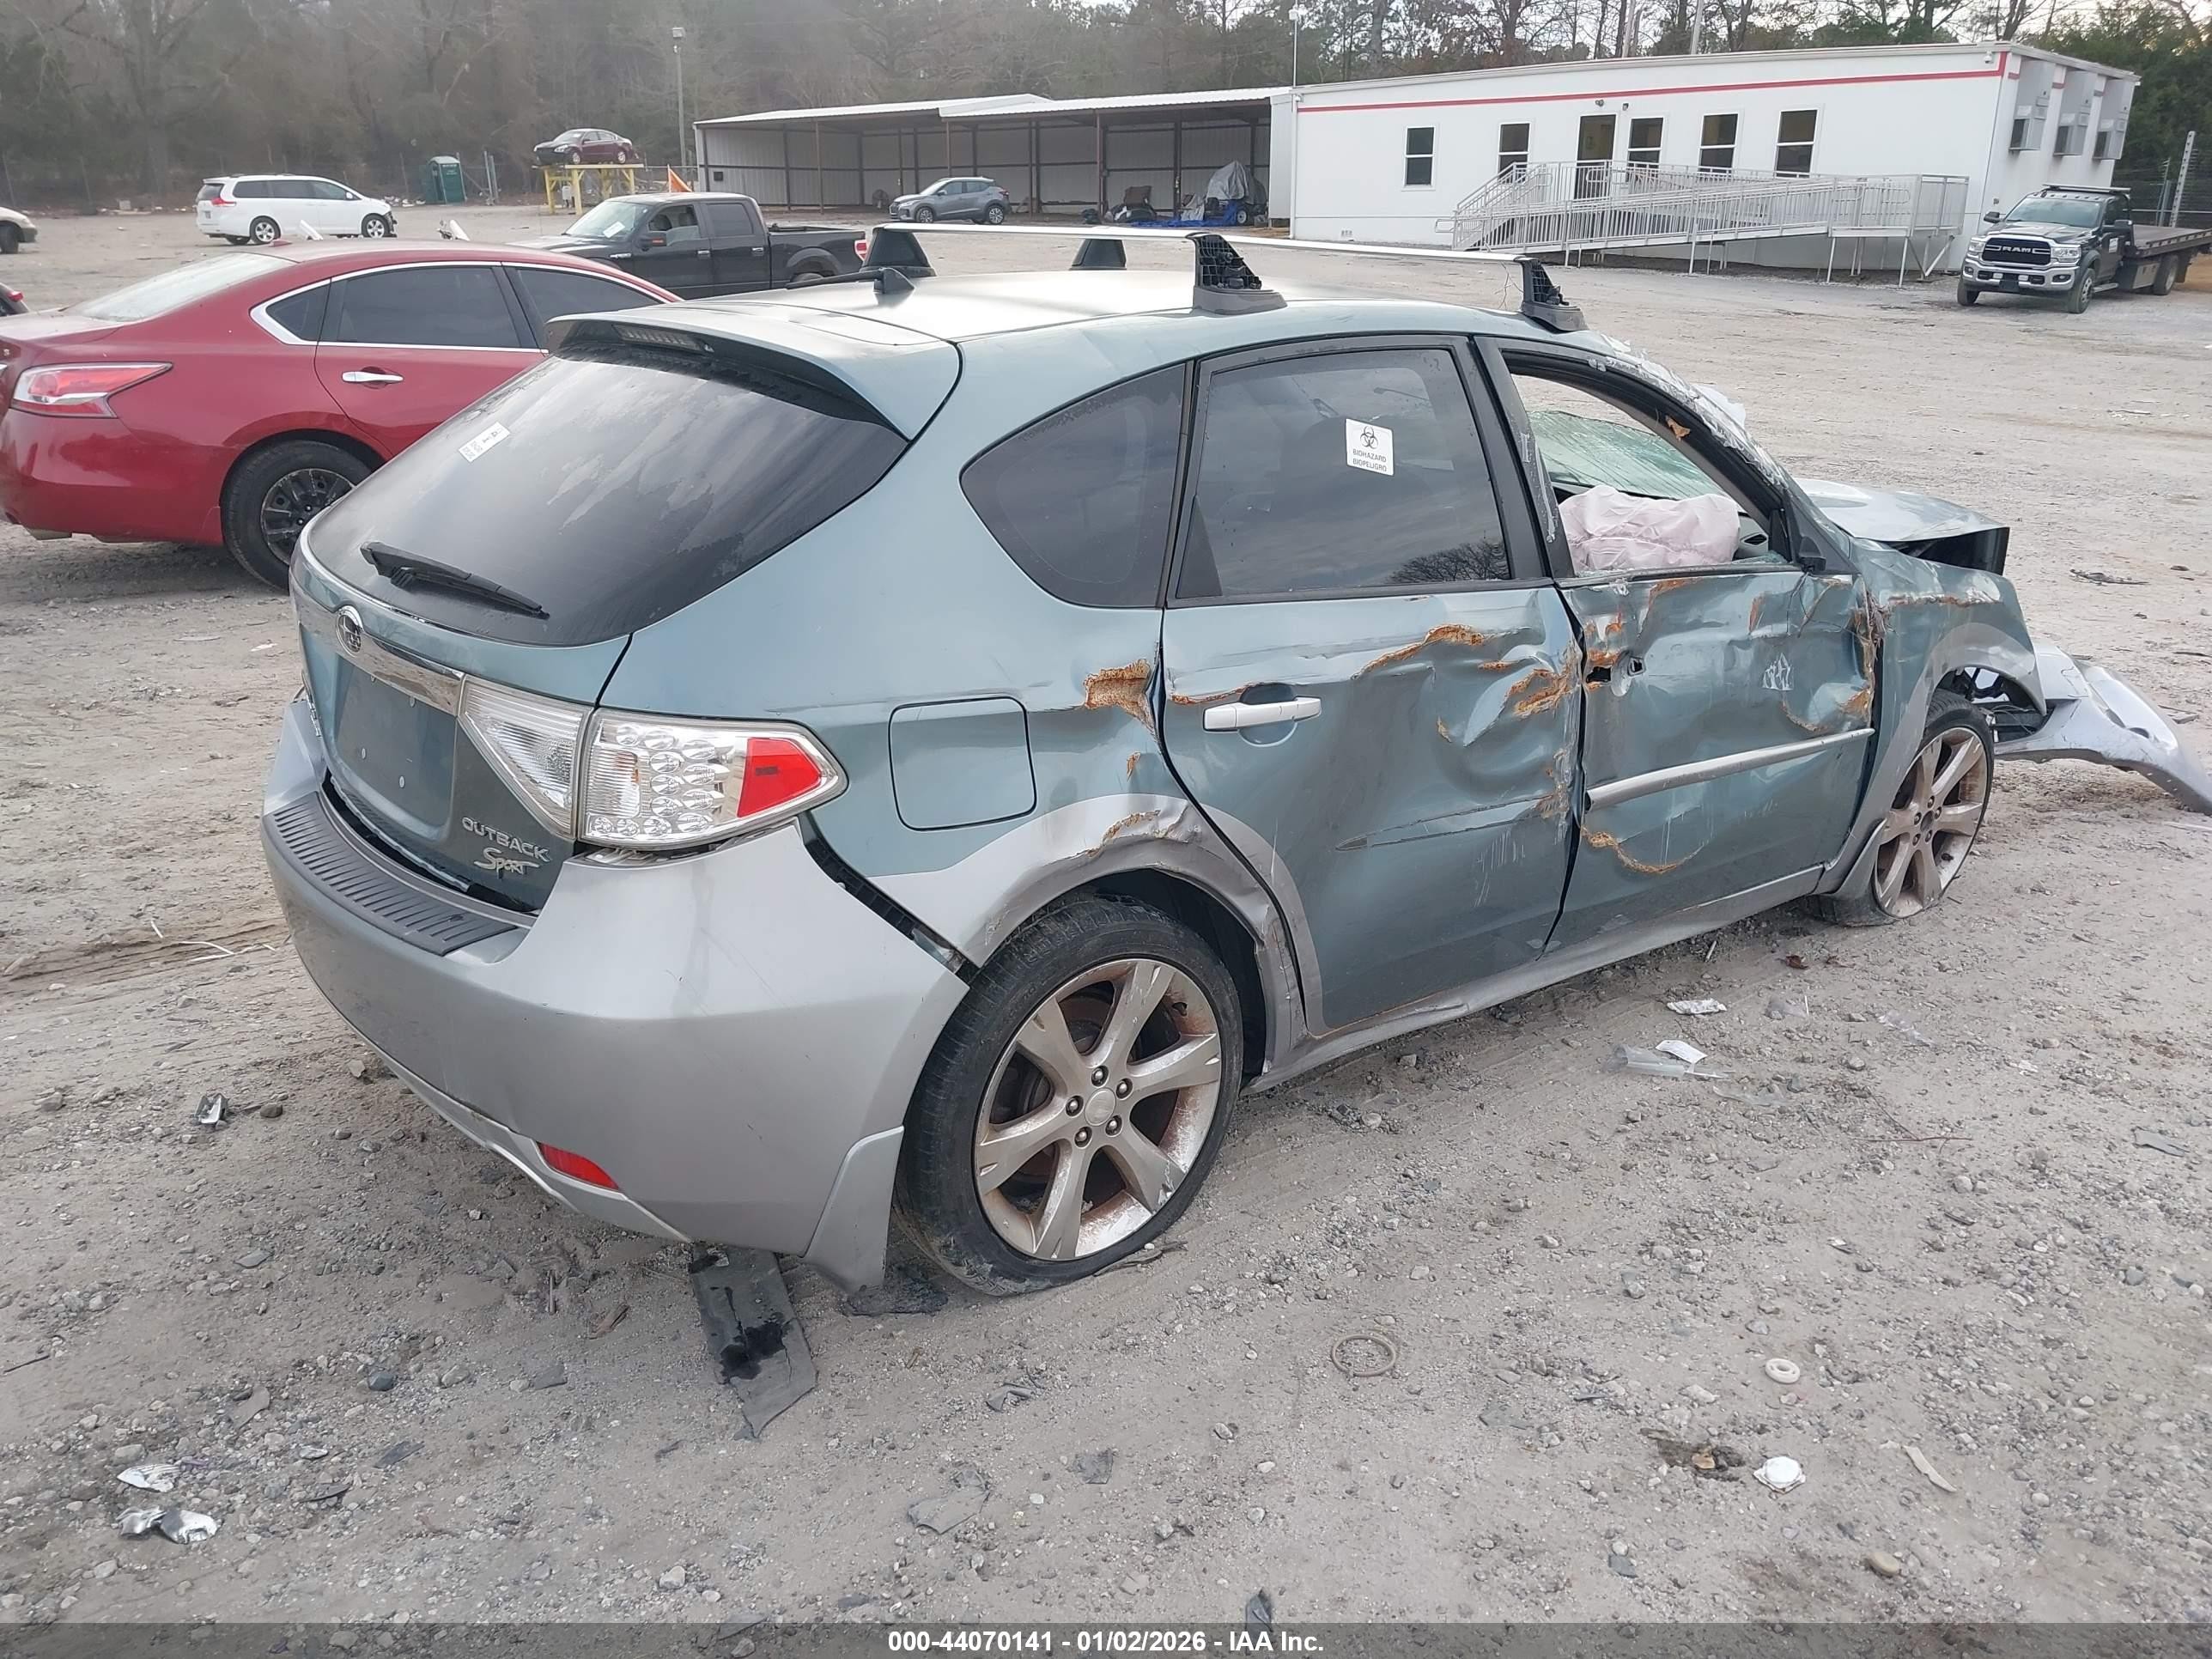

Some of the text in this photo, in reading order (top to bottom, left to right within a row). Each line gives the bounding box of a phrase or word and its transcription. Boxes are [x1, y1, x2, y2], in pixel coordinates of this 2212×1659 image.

[1352, 448, 1387, 463] BIOHAZARD
[1352, 458, 1388, 472] BIOPELIGRO
[462, 817, 551, 862] OUTBACK
